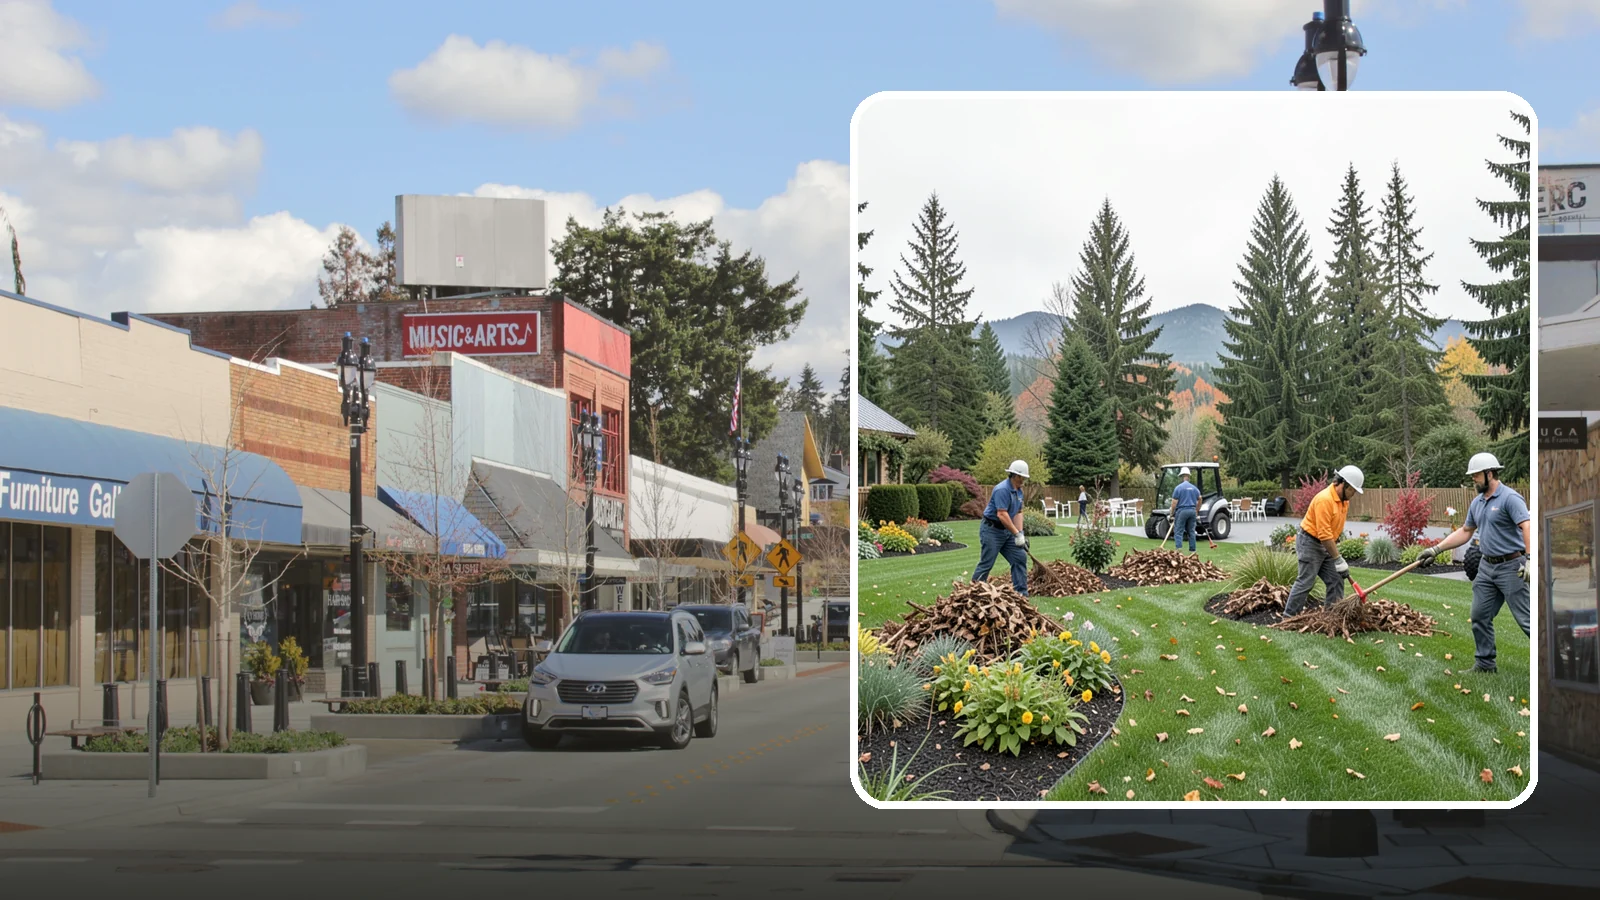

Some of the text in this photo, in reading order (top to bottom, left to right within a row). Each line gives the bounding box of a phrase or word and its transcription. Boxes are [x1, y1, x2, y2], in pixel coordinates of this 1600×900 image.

[408, 323, 519, 349] MUSIC&ARTS
[0, 471, 121, 519] Furniture Gal
[453, 562, 480, 575] SUSHI
